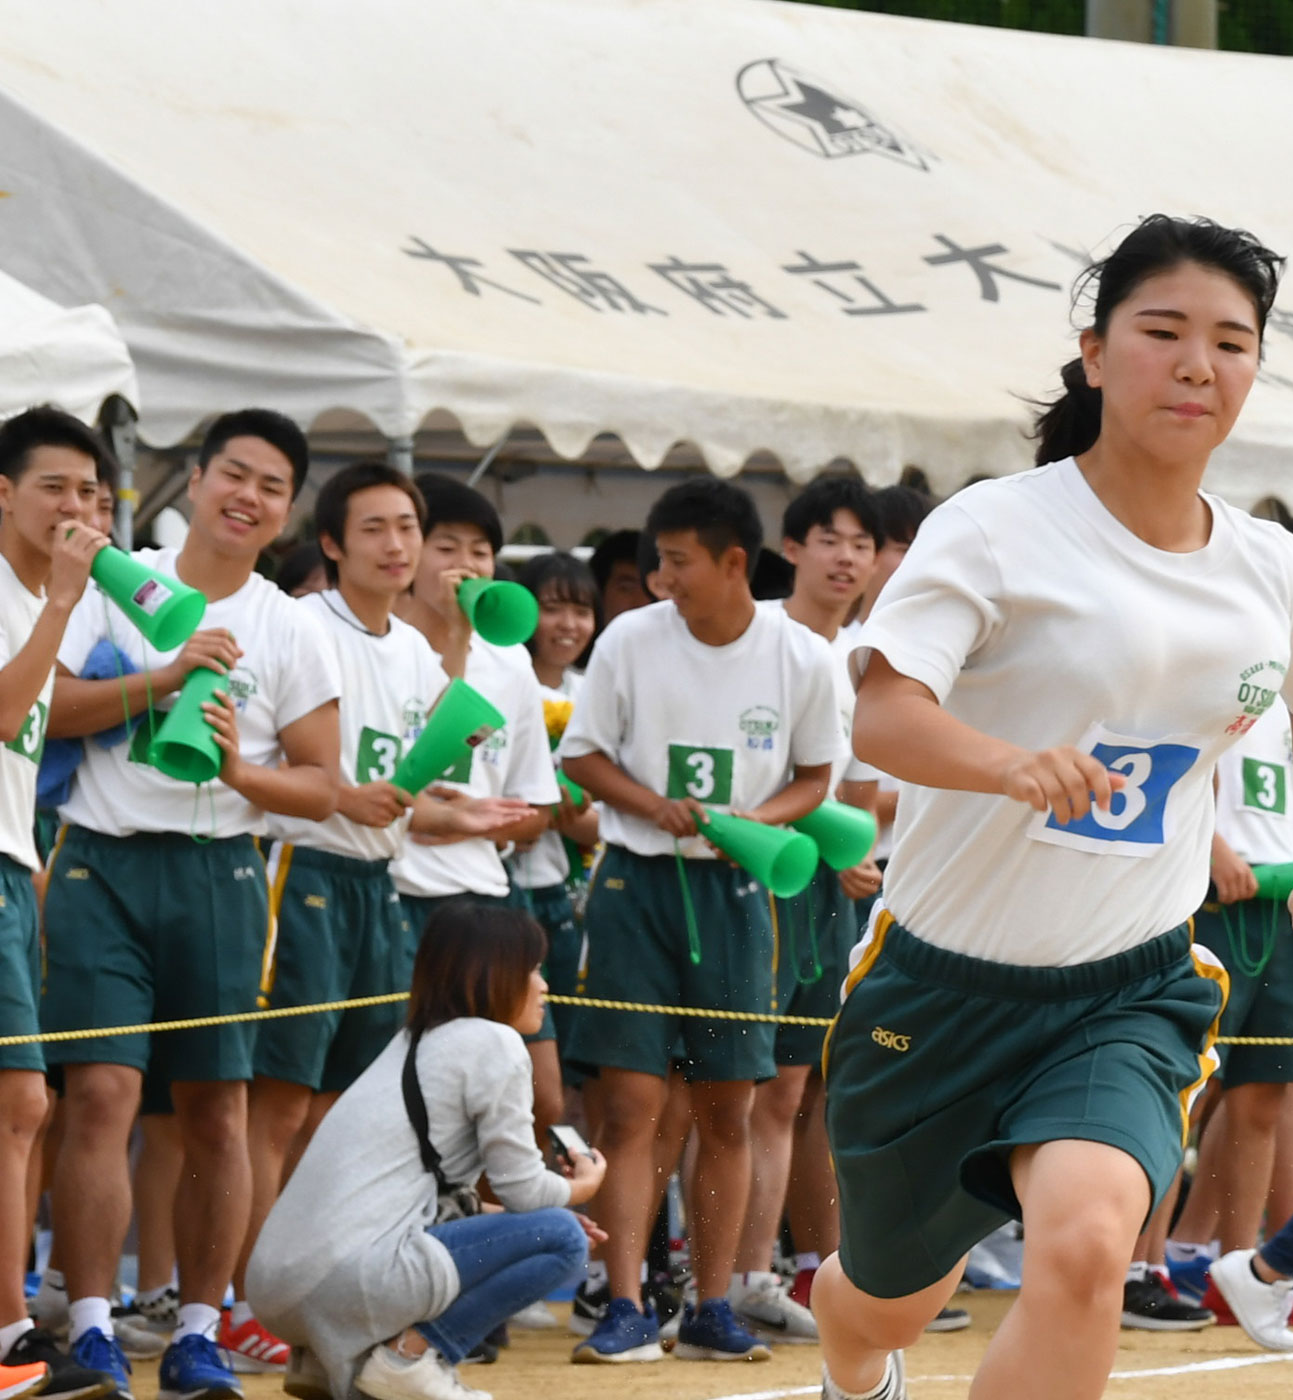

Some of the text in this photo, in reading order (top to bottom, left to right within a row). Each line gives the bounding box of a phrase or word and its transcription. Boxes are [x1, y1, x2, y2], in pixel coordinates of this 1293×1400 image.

[22, 702, 42, 754] 3
[368, 736, 398, 782] 3
[685, 751, 715, 799] 3
[1256, 765, 1277, 809] 3
[871, 1026, 911, 1051] asics
